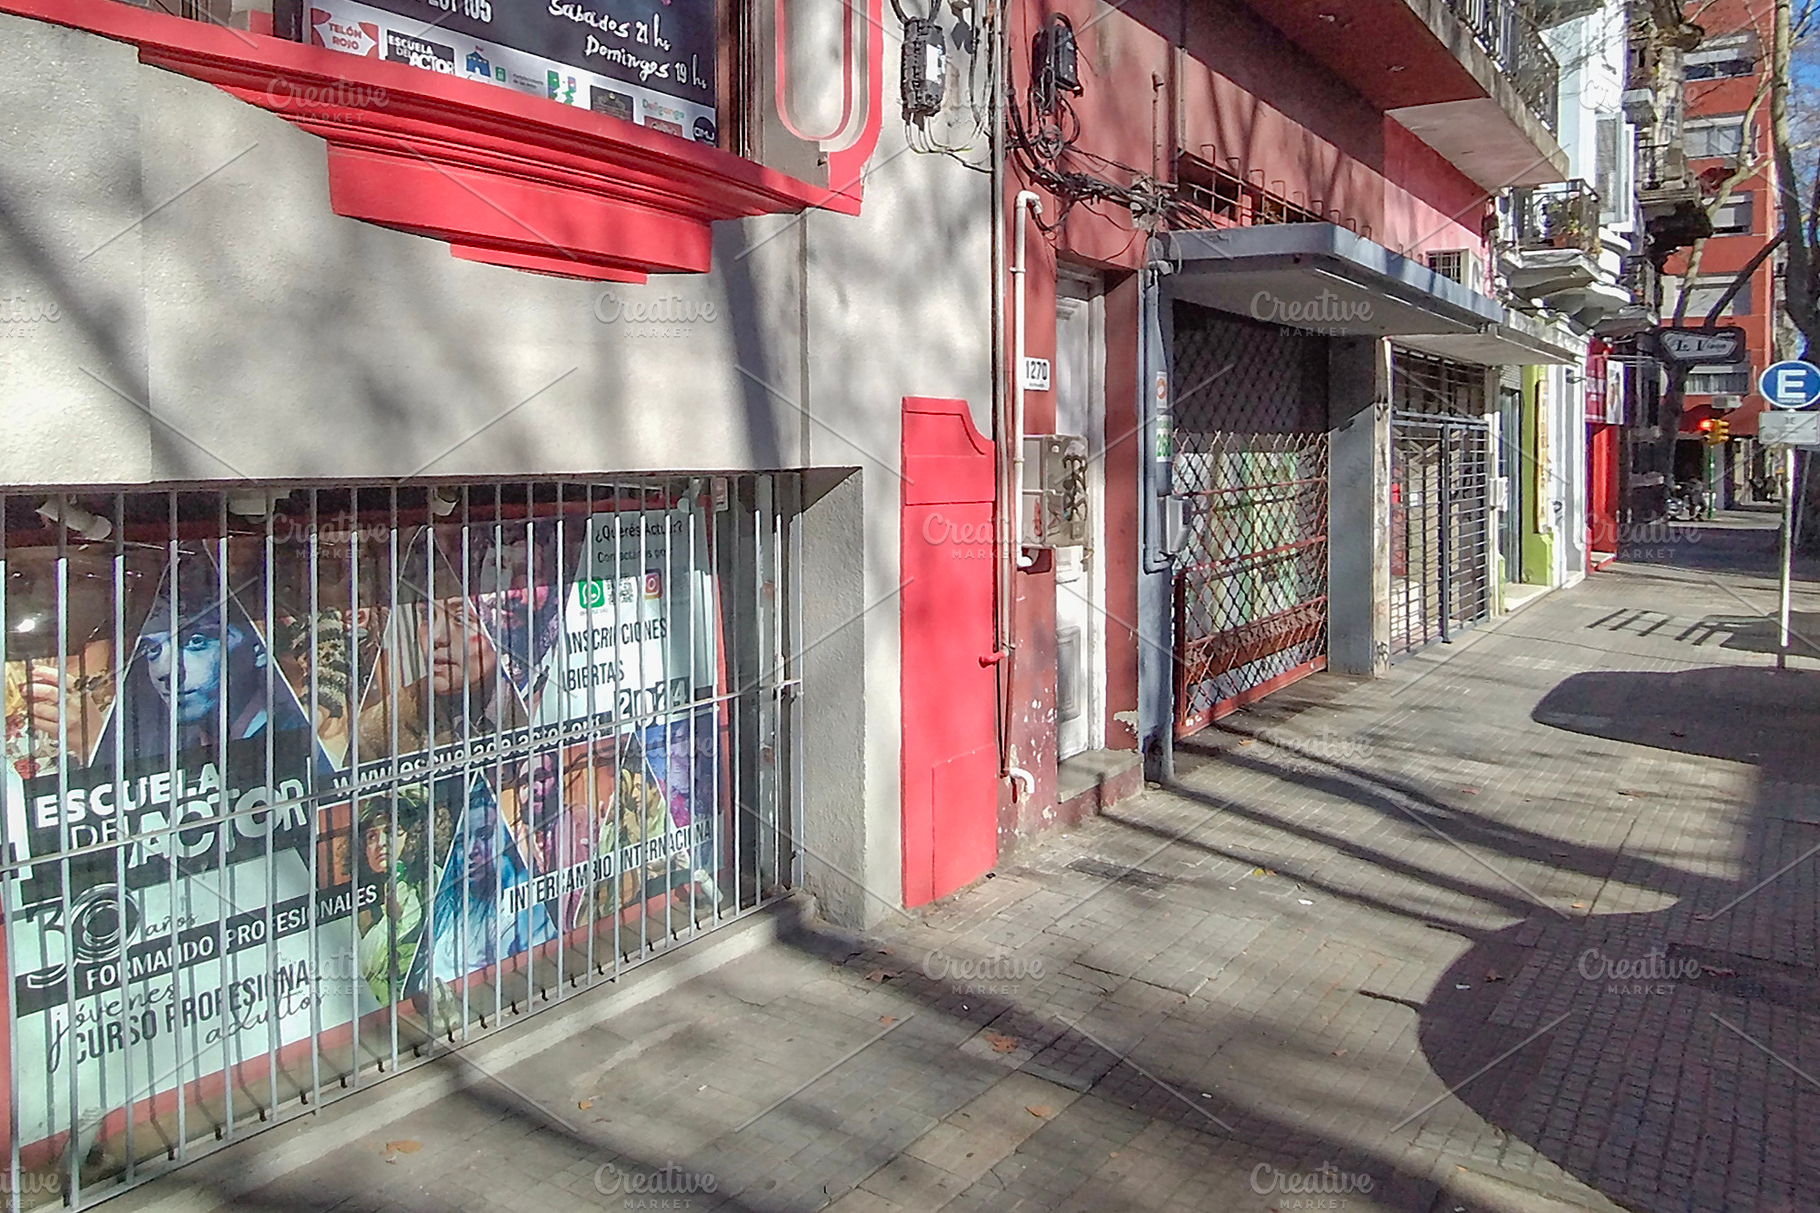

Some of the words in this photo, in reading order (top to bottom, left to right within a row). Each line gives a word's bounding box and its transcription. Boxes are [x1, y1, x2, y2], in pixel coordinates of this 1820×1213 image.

[328, 22, 363, 40] TELÓN
[331, 34, 361, 51] ROJO
[387, 34, 434, 55] ESCUELA
[635, 21, 649, 45] 21
[675, 62, 688, 84] 19
[1025, 359, 1048, 381] 1270
[1777, 369, 1807, 399] E
[567, 617, 668, 655] INSCRICIONES
[562, 659, 625, 693] BIERTAS
[34, 762, 220, 829] ESCUELA
[70, 814, 130, 852] DEL
[128, 779, 308, 869] ACTOR
[74, 1006, 157, 1066] CURSO
